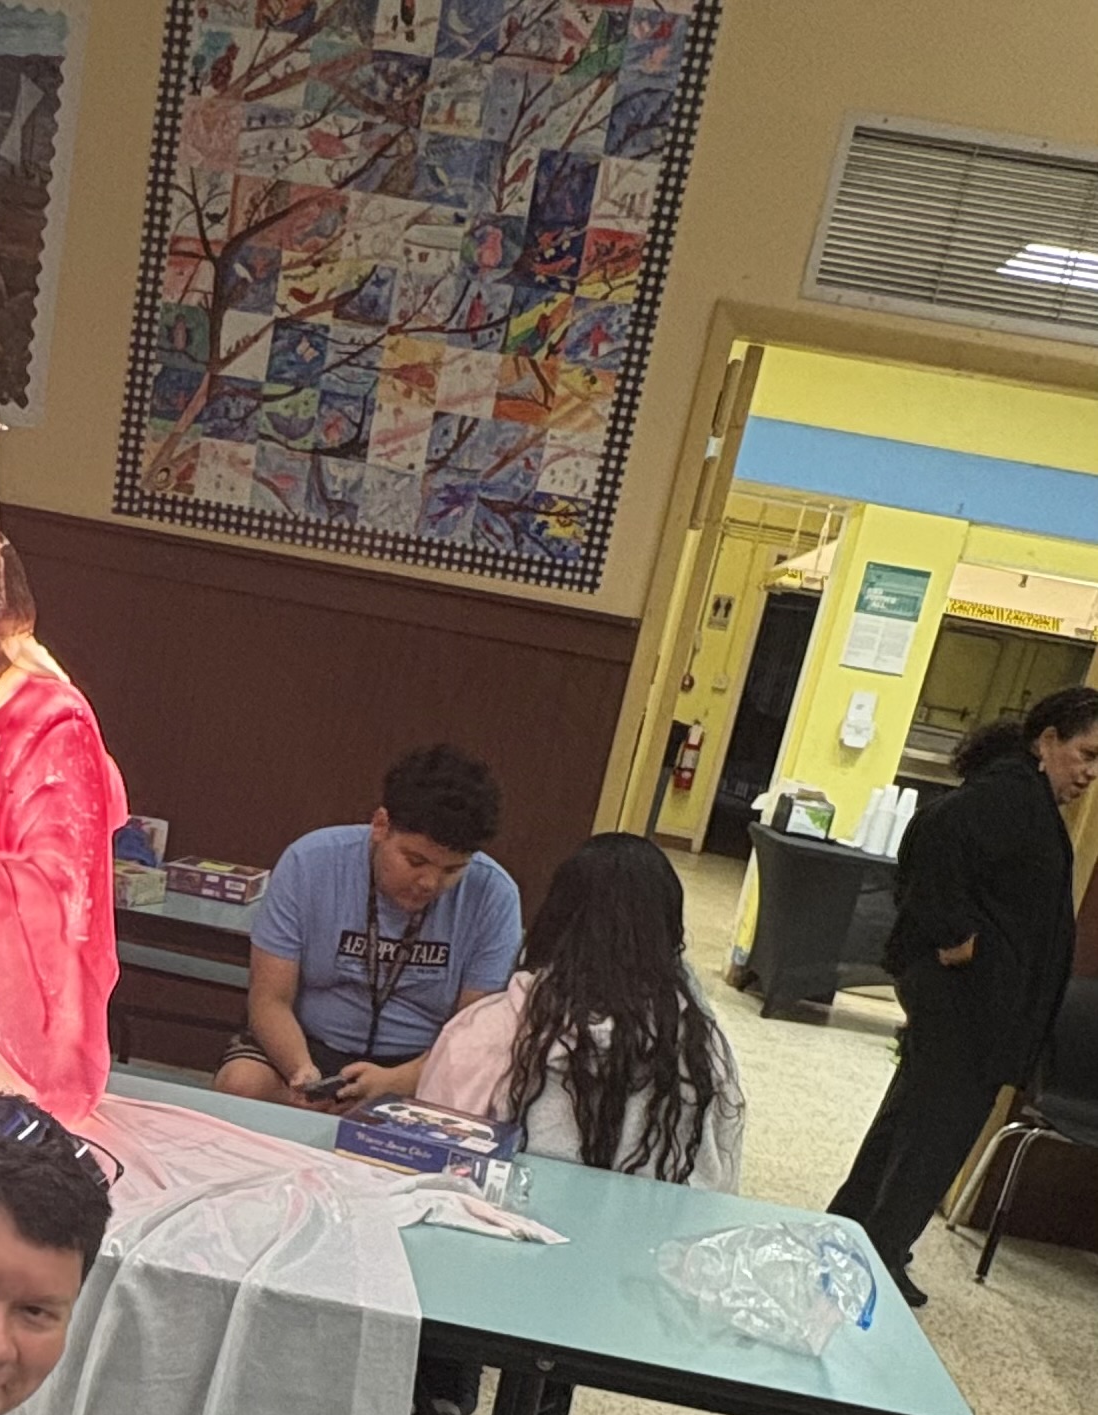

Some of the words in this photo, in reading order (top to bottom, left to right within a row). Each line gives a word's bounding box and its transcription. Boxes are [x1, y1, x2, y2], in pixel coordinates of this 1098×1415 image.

[951, 600, 995, 616] CAUTION
[1006, 610, 1051, 627] CAUTION
[343, 935, 449, 964] AEPOTALE
